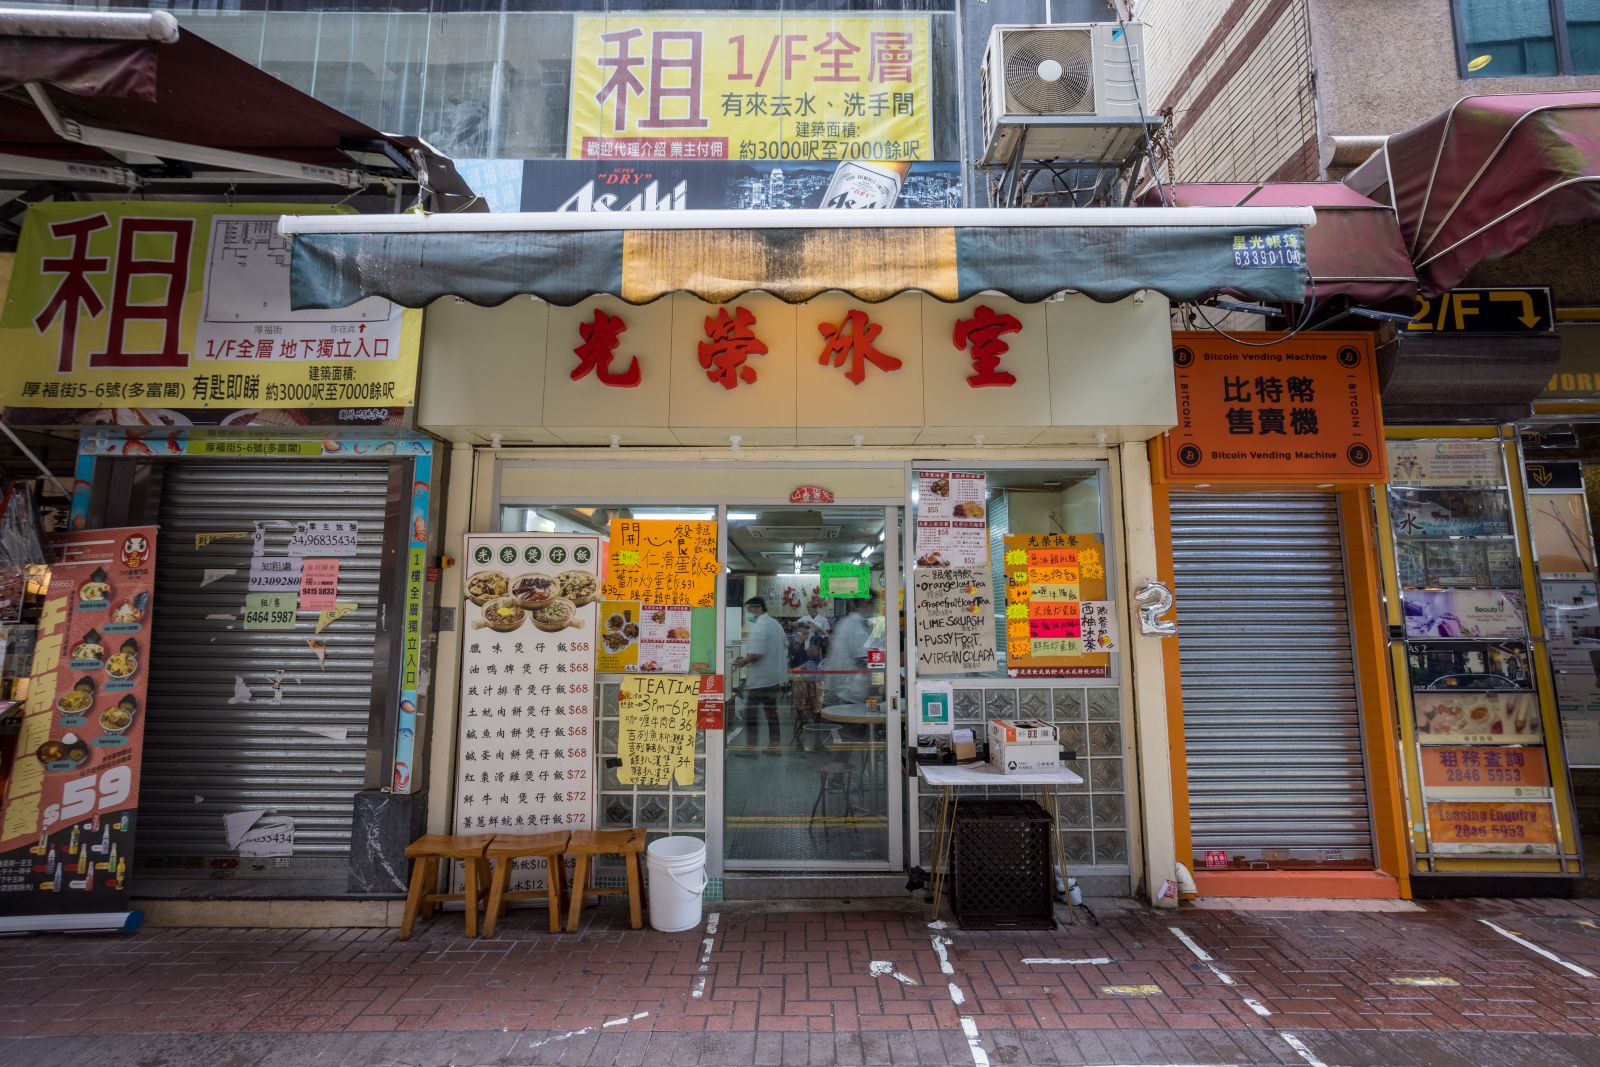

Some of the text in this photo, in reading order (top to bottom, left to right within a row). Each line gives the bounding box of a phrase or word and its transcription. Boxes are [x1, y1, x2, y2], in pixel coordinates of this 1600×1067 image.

[727, 31, 914, 88] 1/F全層
[596, 27, 710, 134] 租
[795, 121, 861, 139] 建築面積:
[586, 142, 723, 159] 歡迎代理介紹 業主付佣
[739, 139, 920, 161] 約3000呎至7000餘呎
[33, 212, 196, 374] 租
[205, 337, 390, 361] 1/F全層 地下獨立入口
[570, 304, 1024, 391] 光榮冰室
[1203, 353, 1328, 363] Bitcoin Vending Machine
[308, 366, 357, 382] 建築面積:
[21, 374, 395, 402] 厚福街5-6號(多富閣) 有匙即睇 約3000呎至7000餘呎
[1223, 375, 1315, 404] 比特幣
[1180, 383, 1193, 429] BITCOIN
[1348, 383, 1361, 428] BITCOIN
[1225, 407, 1319, 436] 售賣機
[204, 441, 302, 455] 厚福街5-6號(多富閣)
[1211, 450, 1338, 461] Bitcoin Vending Machine
[927, 506, 939, 514] $55
[309, 522, 358, 532] 業主放盤
[1399, 512, 1425, 535] 水
[307, 535, 357, 547] 96835434
[476, 547, 590, 563] 光榮煲仔飯
[921, 581, 956, 593] Orange
[970, 579, 986, 589] Tea
[246, 610, 294, 623] 6464 5987
[406, 554, 421, 684] 1樓全層獨立入口
[922, 616, 985, 630] LIME SQUASH
[1081, 602, 1097, 652] 西柚冰茶
[570, 642, 590, 652] $68
[924, 632, 981, 647] PUSSY FOOT
[962, 647, 995, 662] COLADA
[569, 663, 589, 673] $68
[569, 684, 588, 694] $68
[634, 677, 700, 696] TEATIME
[568, 705, 588, 715] $68
[568, 726, 588, 736] $68
[679, 718, 692, 731] 36
[567, 748, 587, 758] $68
[1439, 750, 1525, 768] 租務查詢
[676, 756, 691, 768] 34
[567, 769, 586, 779] $72
[1446, 768, 1522, 782] 2846 5953
[42, 765, 132, 827] $59
[463, 791, 586, 806] 鮮牛肉煲仔飯 $72
[565, 813, 586, 824] $72
[1439, 808, 1537, 824] Leasing Enquiry
[1454, 824, 1525, 838] 2846 5953
